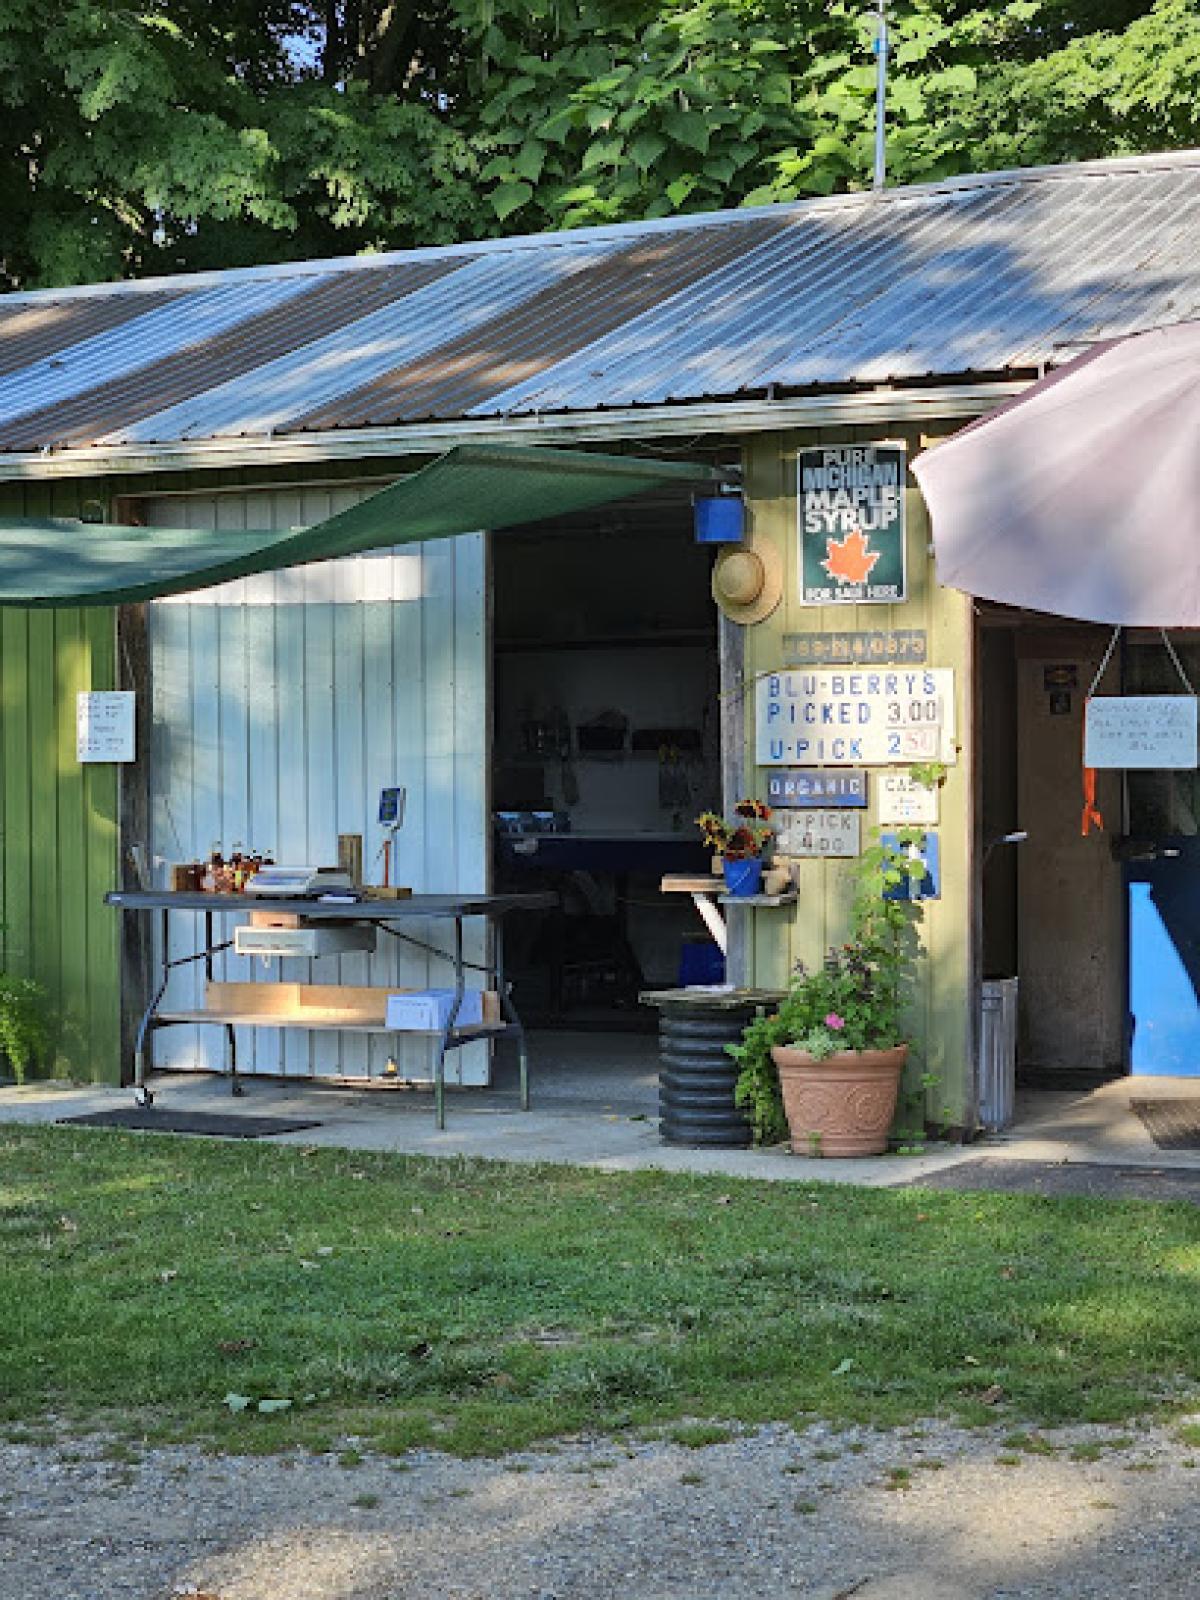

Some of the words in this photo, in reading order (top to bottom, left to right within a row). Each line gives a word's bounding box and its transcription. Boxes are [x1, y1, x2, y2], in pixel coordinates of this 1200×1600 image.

[822, 449, 877, 466] PURE
[803, 463, 897, 490] MICHIGAN
[805, 486, 896, 510] MAPLE
[805, 508, 898, 533] SYRUP
[768, 702, 872, 724] PICKED
[887, 700, 936, 724] 3.00
[770, 737, 863, 760] U-PICK
[769, 778, 860, 795] ORGANIC
[782, 813, 852, 831] U-PICK
